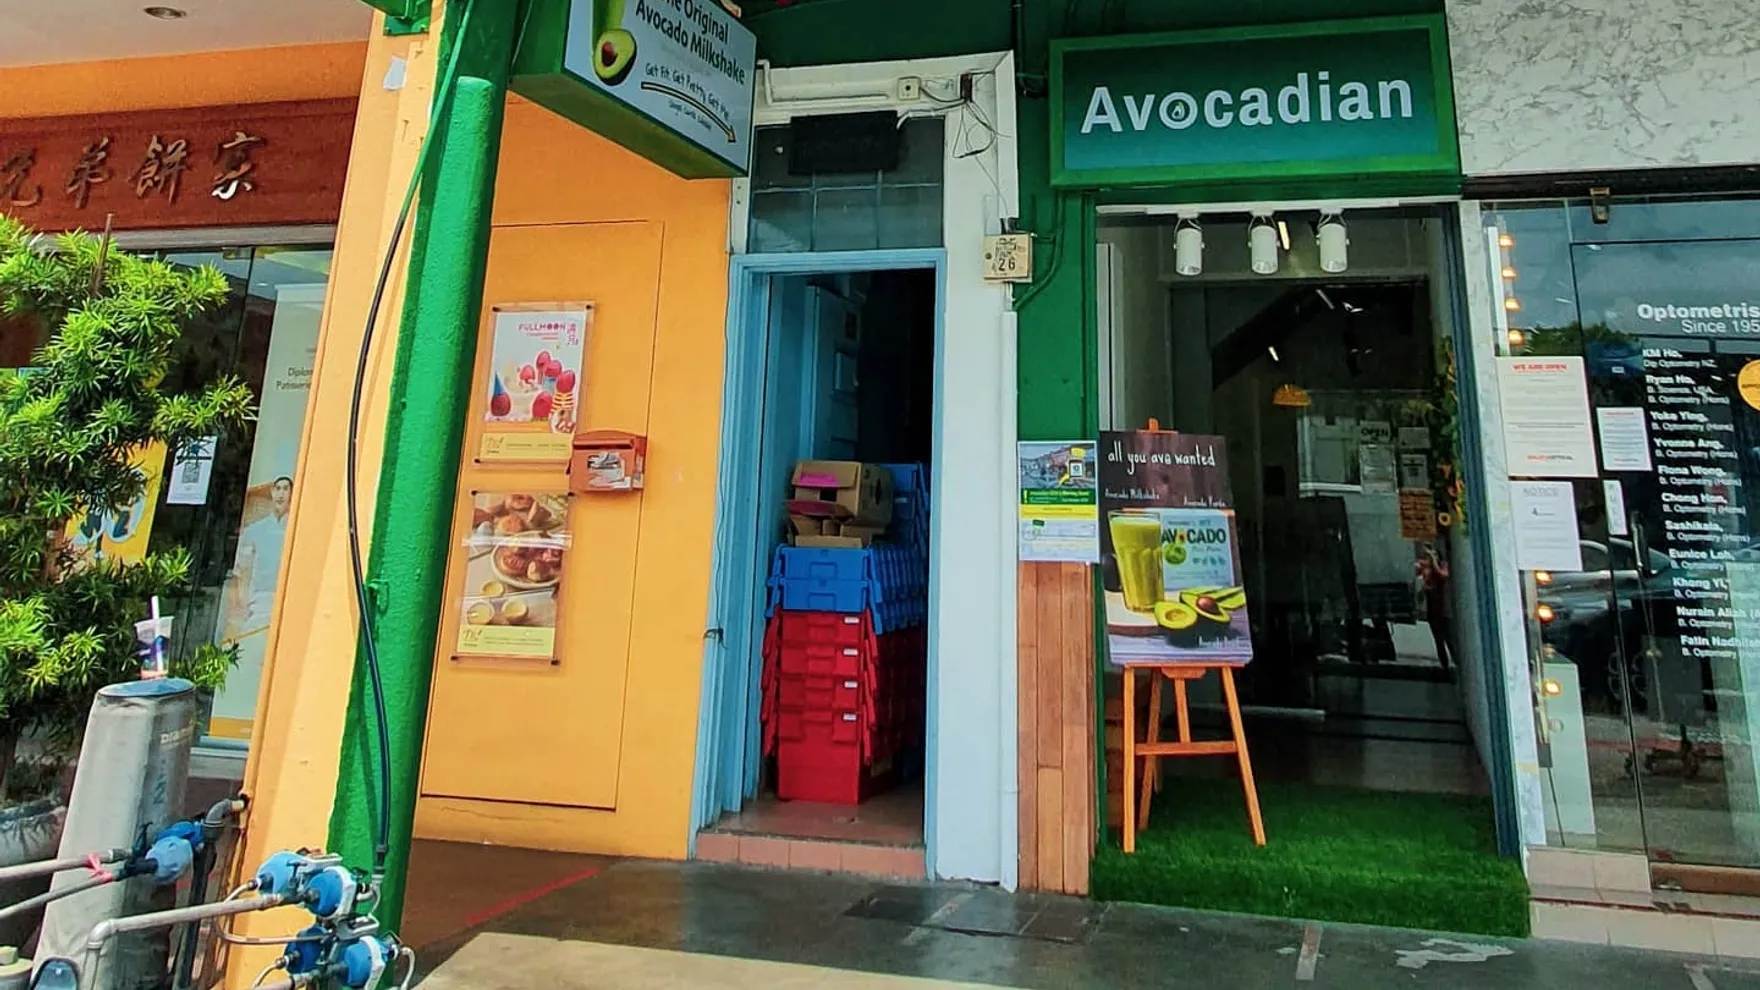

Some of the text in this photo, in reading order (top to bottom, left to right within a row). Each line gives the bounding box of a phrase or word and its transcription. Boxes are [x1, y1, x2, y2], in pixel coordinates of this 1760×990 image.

[684, 0, 729, 44] Original
[636, 0, 745, 85] Avocado Milkshake
[1080, 71, 1413, 134] Avocadian
[1681, 319, 1727, 333] Since
[1659, 396, 1700, 404] Optometry
[1662, 423, 1704, 431] Optometry
[1108, 440, 1122, 463] all
[1127, 451, 1146, 475] you
[1175, 443, 1215, 467] wanted
[1666, 450, 1708, 459] Optometry
[1669, 477, 1713, 486] Optometry
[1523, 487, 1558, 496] NOTICE
[1673, 505, 1716, 514] Optometry
[1677, 533, 1721, 542] Optometry
[1668, 549, 1708, 558] Eunice
